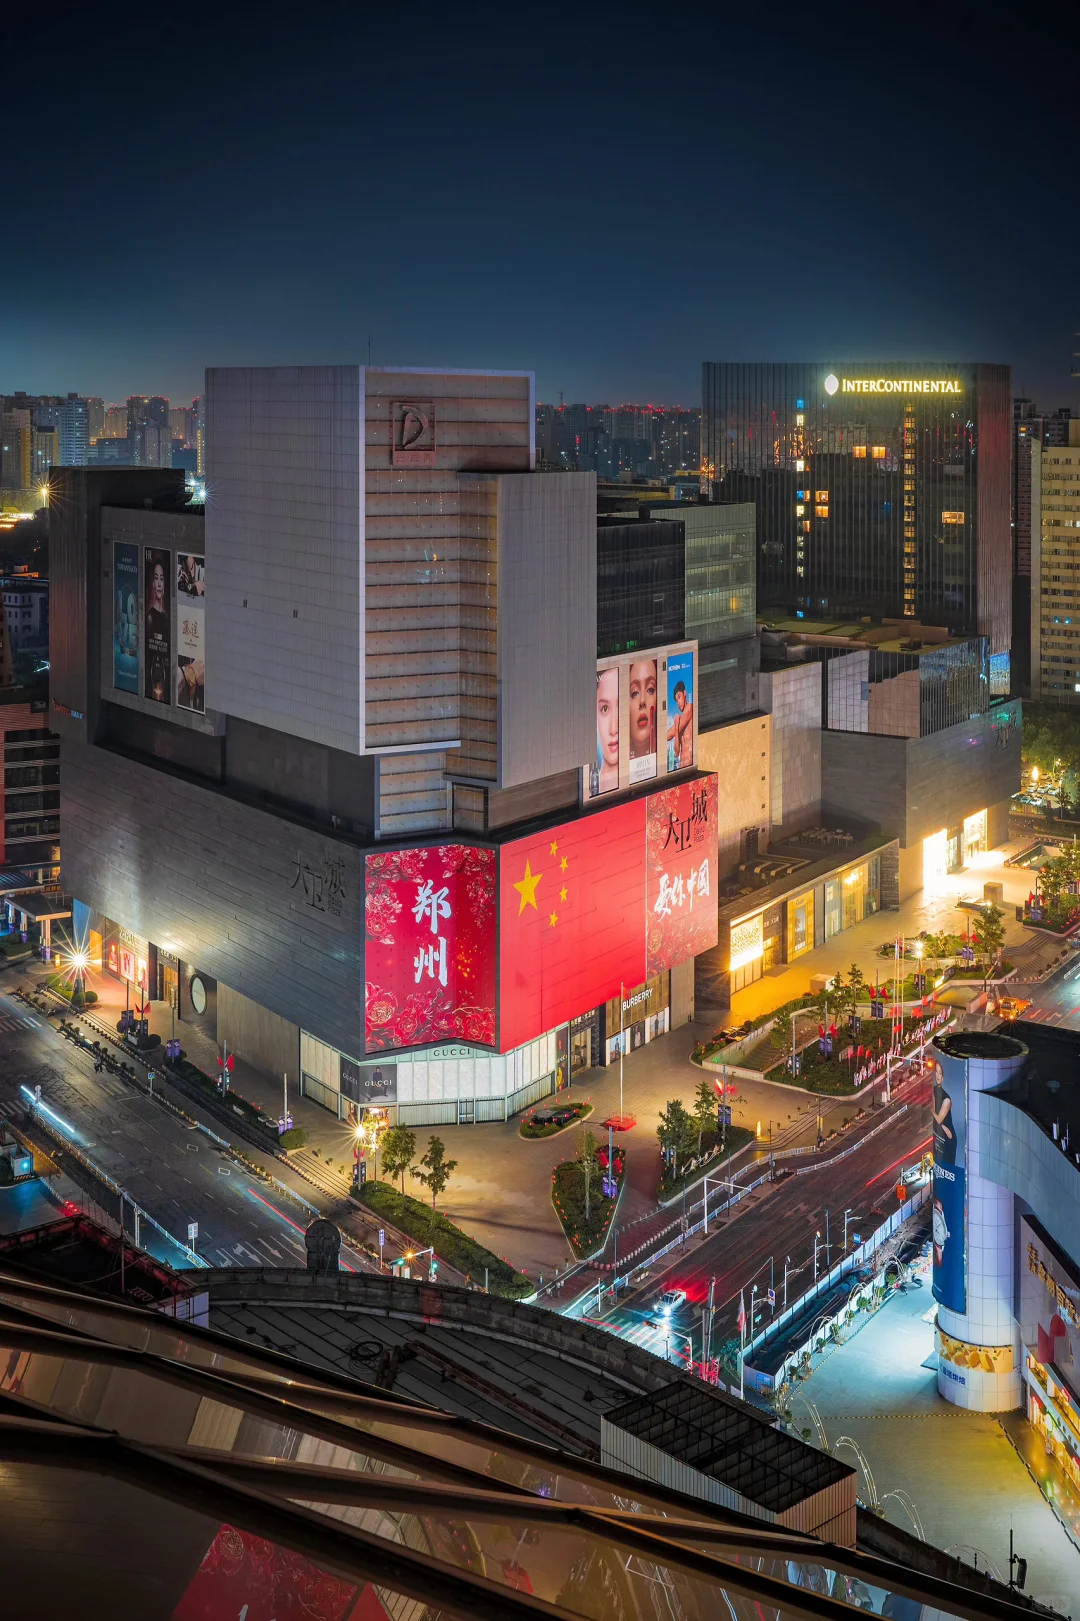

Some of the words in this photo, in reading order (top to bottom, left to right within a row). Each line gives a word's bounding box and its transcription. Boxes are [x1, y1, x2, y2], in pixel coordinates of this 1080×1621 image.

[662, 789, 708, 853] 大卫城
[291, 848, 346, 912] 大卫城
[411, 879, 452, 987] 郑州
[621, 988, 654, 1012] BURBERRY
[433, 1048, 471, 1057] GUCCI
[342, 1072, 358, 1085] GUCCI
